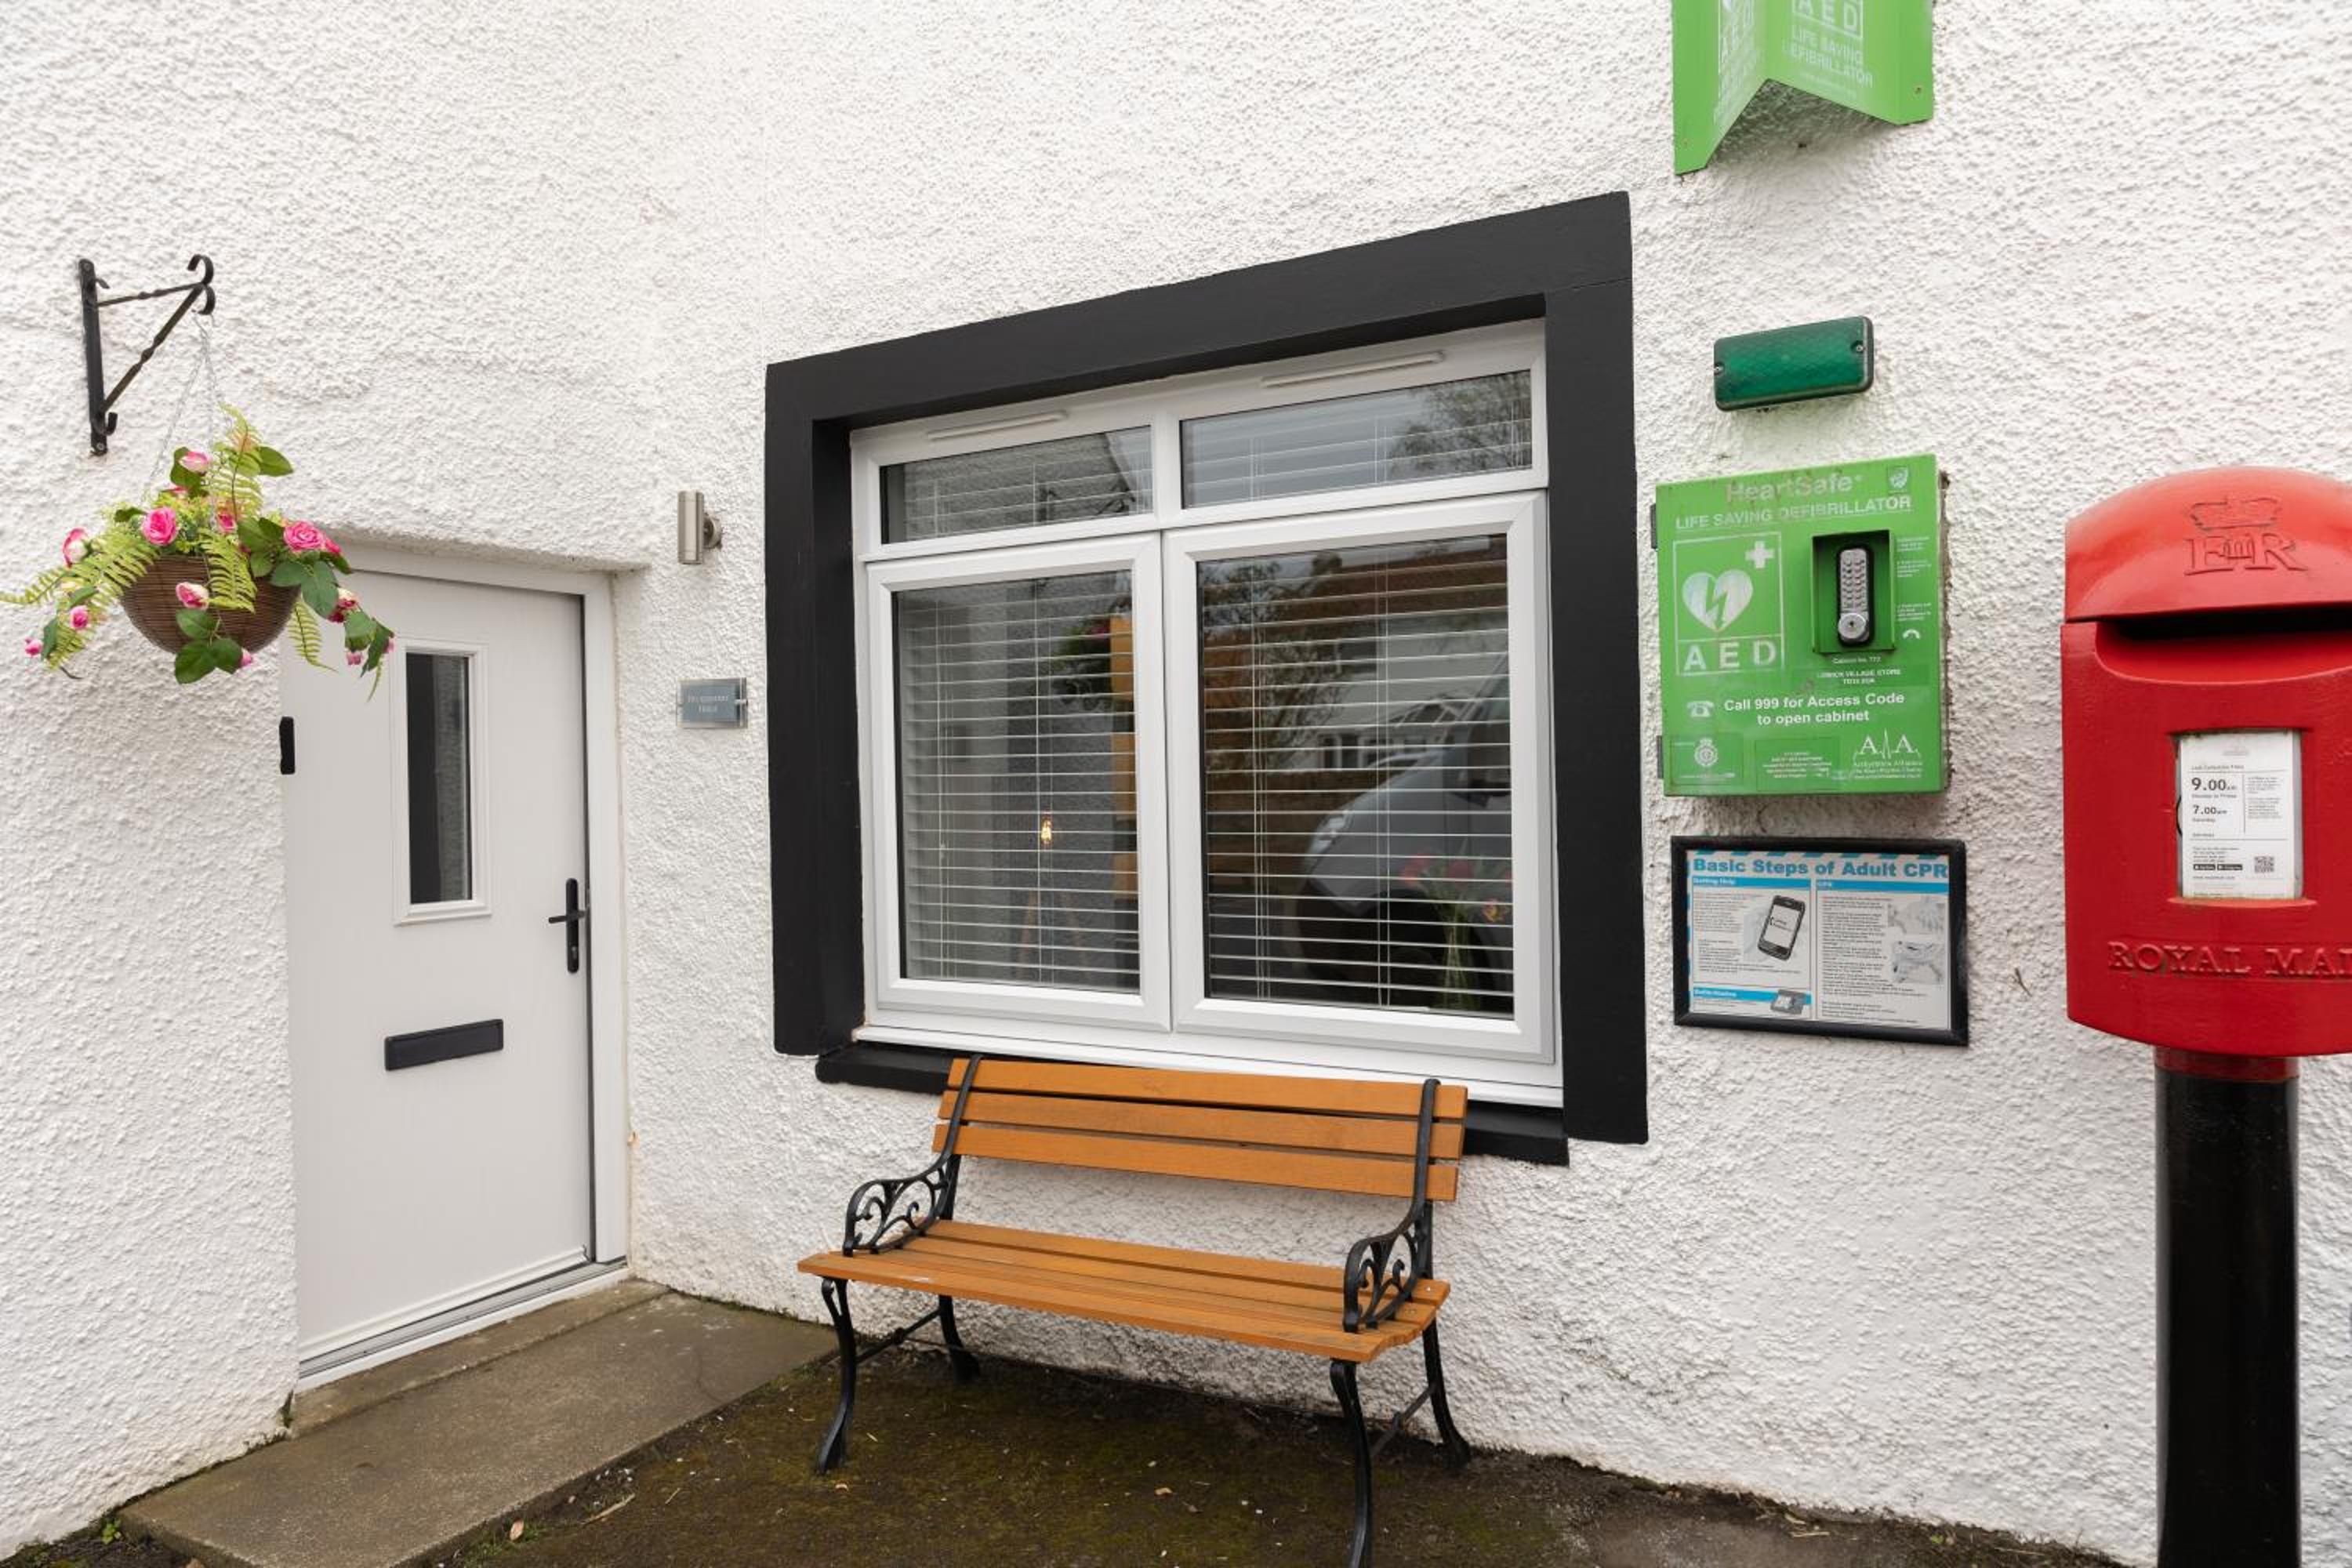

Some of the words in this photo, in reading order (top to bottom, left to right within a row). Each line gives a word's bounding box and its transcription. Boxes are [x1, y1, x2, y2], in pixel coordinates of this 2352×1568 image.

[1675, 514, 1710, 530] LIFE
[1714, 509, 1773, 528] SAVING
[1781, 495, 1911, 519] DEFIBRILLATOR
[1724, 699, 1751, 712] Call
[1755, 697, 1779, 710] 999
[1784, 696, 1802, 708] for
[1807, 695, 1860, 707] Access
[1865, 692, 1905, 705] Code
[1757, 714, 1771, 726] to
[1776, 714, 1811, 727] open
[1815, 710, 1869, 723] cabinet
[1693, 858, 1745, 873] Basic
[1752, 860, 1809, 877] Steps
[1815, 861, 1835, 875] of
[1842, 861, 1896, 877] Adult
[1903, 862, 1948, 878] CPR
[2108, 941, 2252, 974] ROYAL
